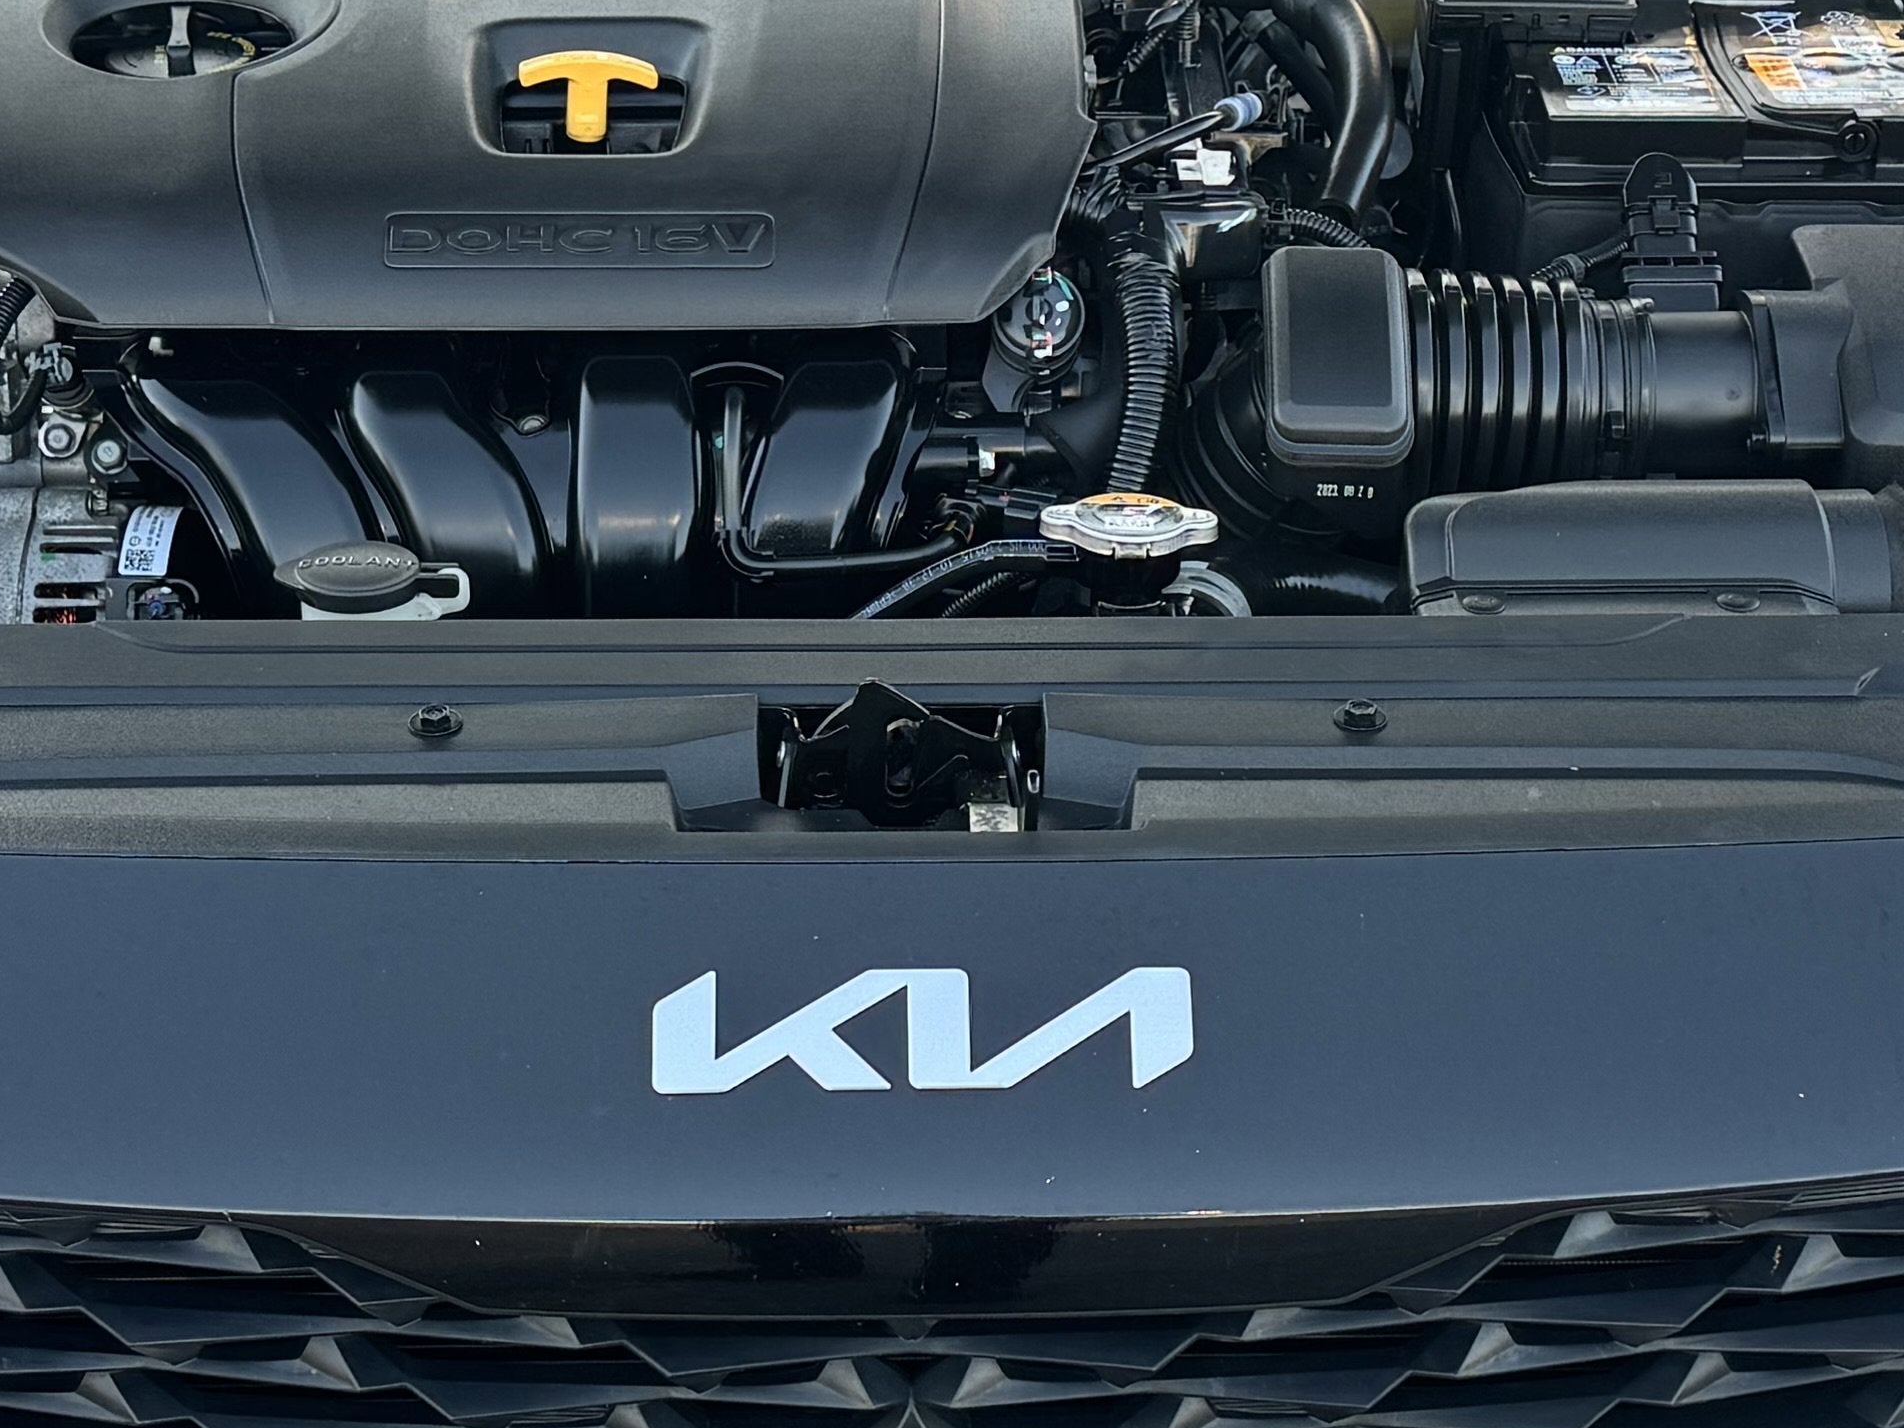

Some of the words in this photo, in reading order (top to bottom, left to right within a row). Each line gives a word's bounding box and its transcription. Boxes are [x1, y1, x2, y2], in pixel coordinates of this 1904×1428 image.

[389, 225, 613, 254] DOHC
[634, 223, 765, 253] 16V
[297, 555, 416, 571] COOLANT
[652, 967, 1194, 1094] KIA
